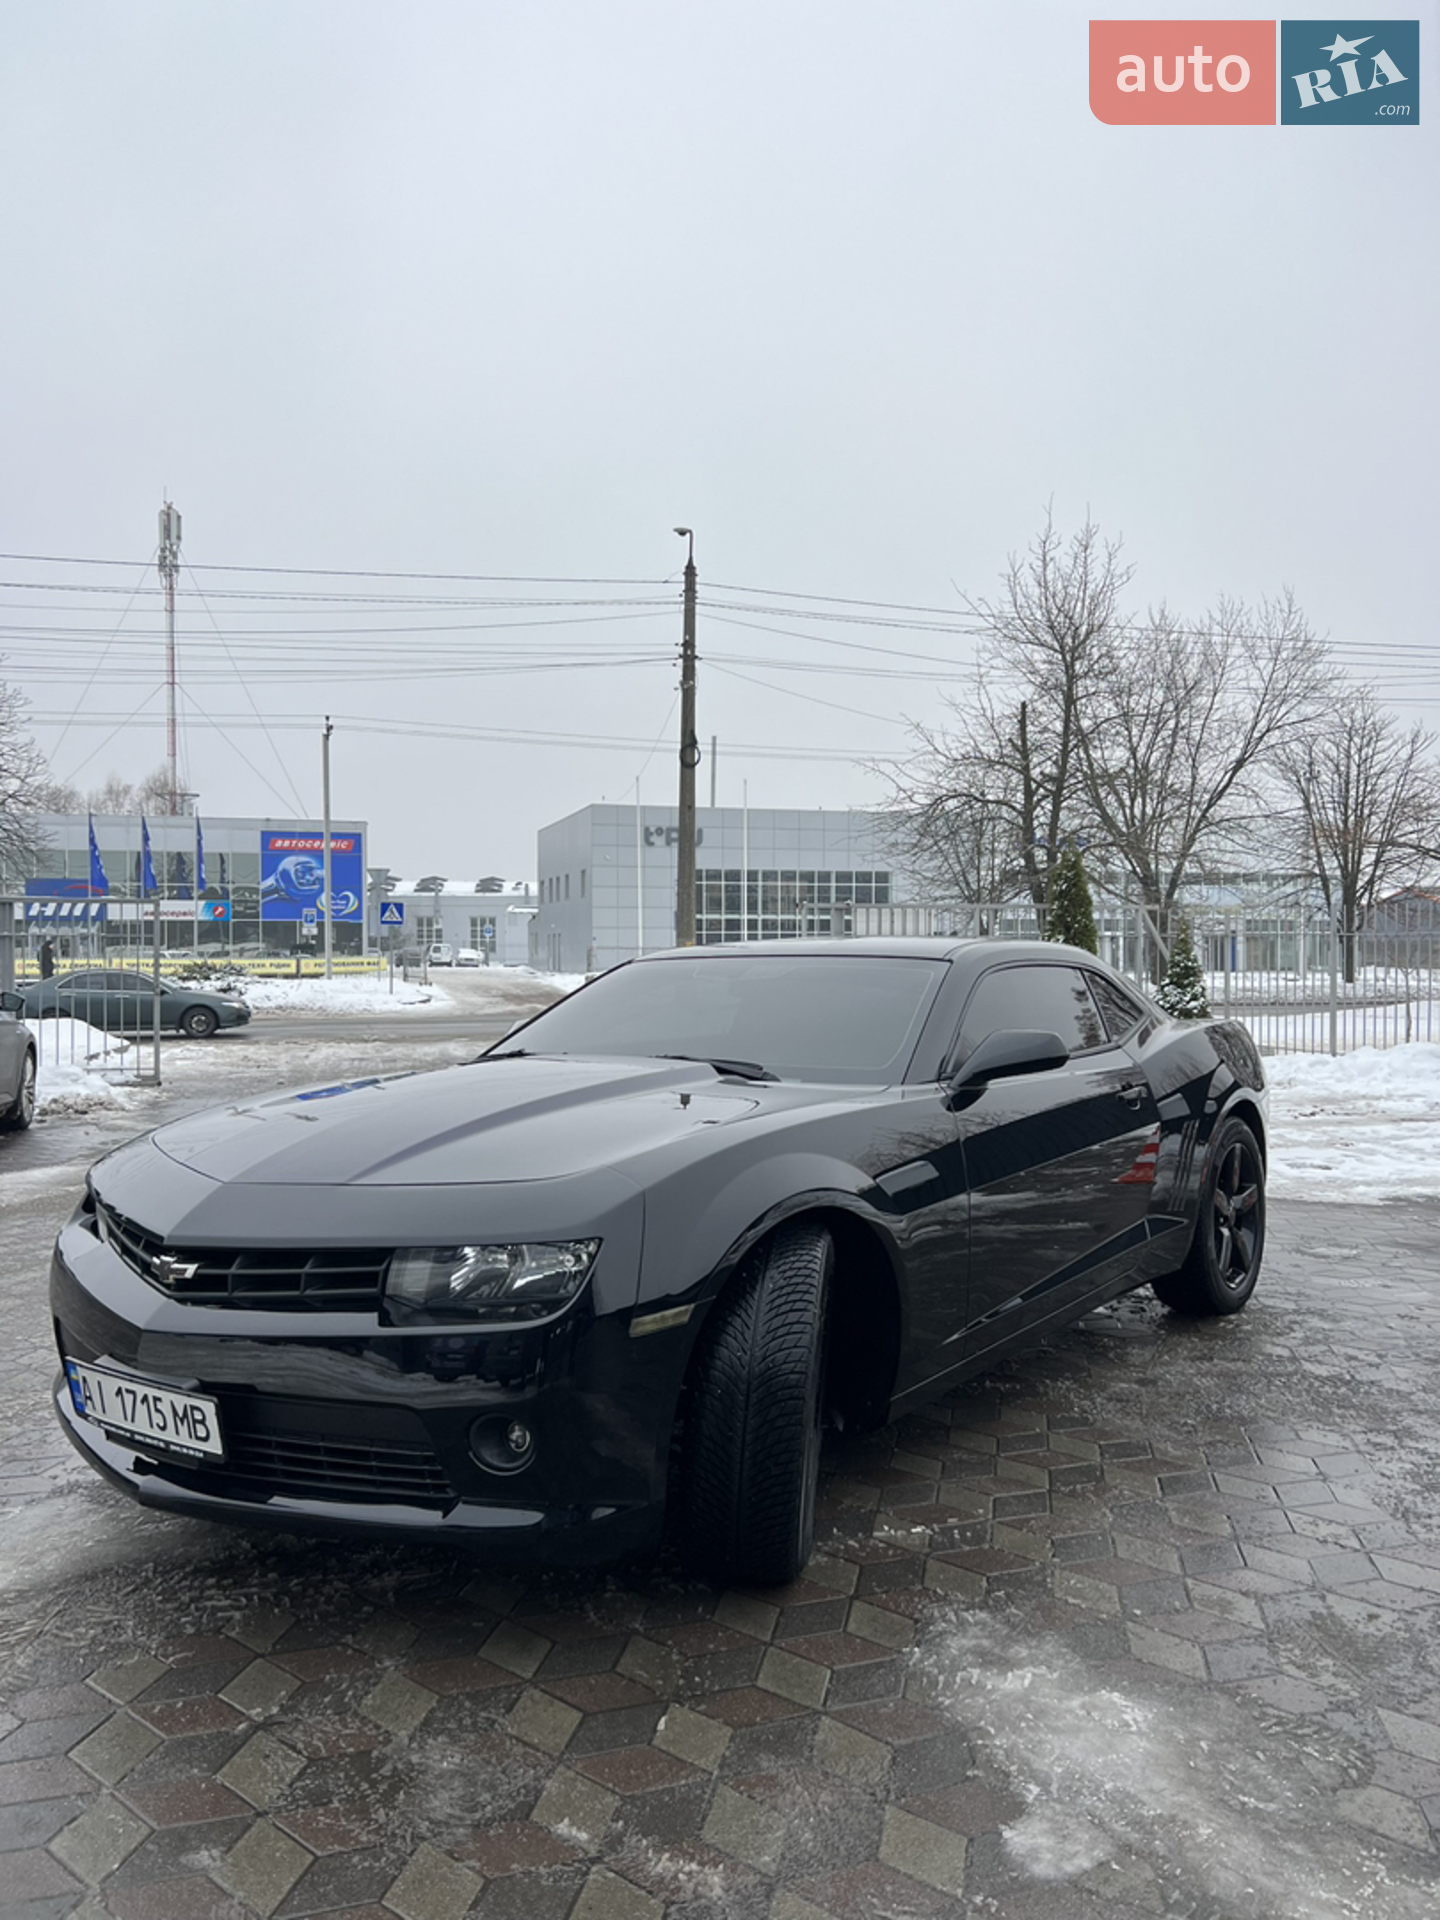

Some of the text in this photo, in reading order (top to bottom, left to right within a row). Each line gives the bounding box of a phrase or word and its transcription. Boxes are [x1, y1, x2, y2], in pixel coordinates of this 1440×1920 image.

[143, 909, 196, 918] авосервіс
[82, 1376, 106, 1415] AI
[115, 1386, 167, 1432] 1715
[170, 1399, 210, 1443] MB
